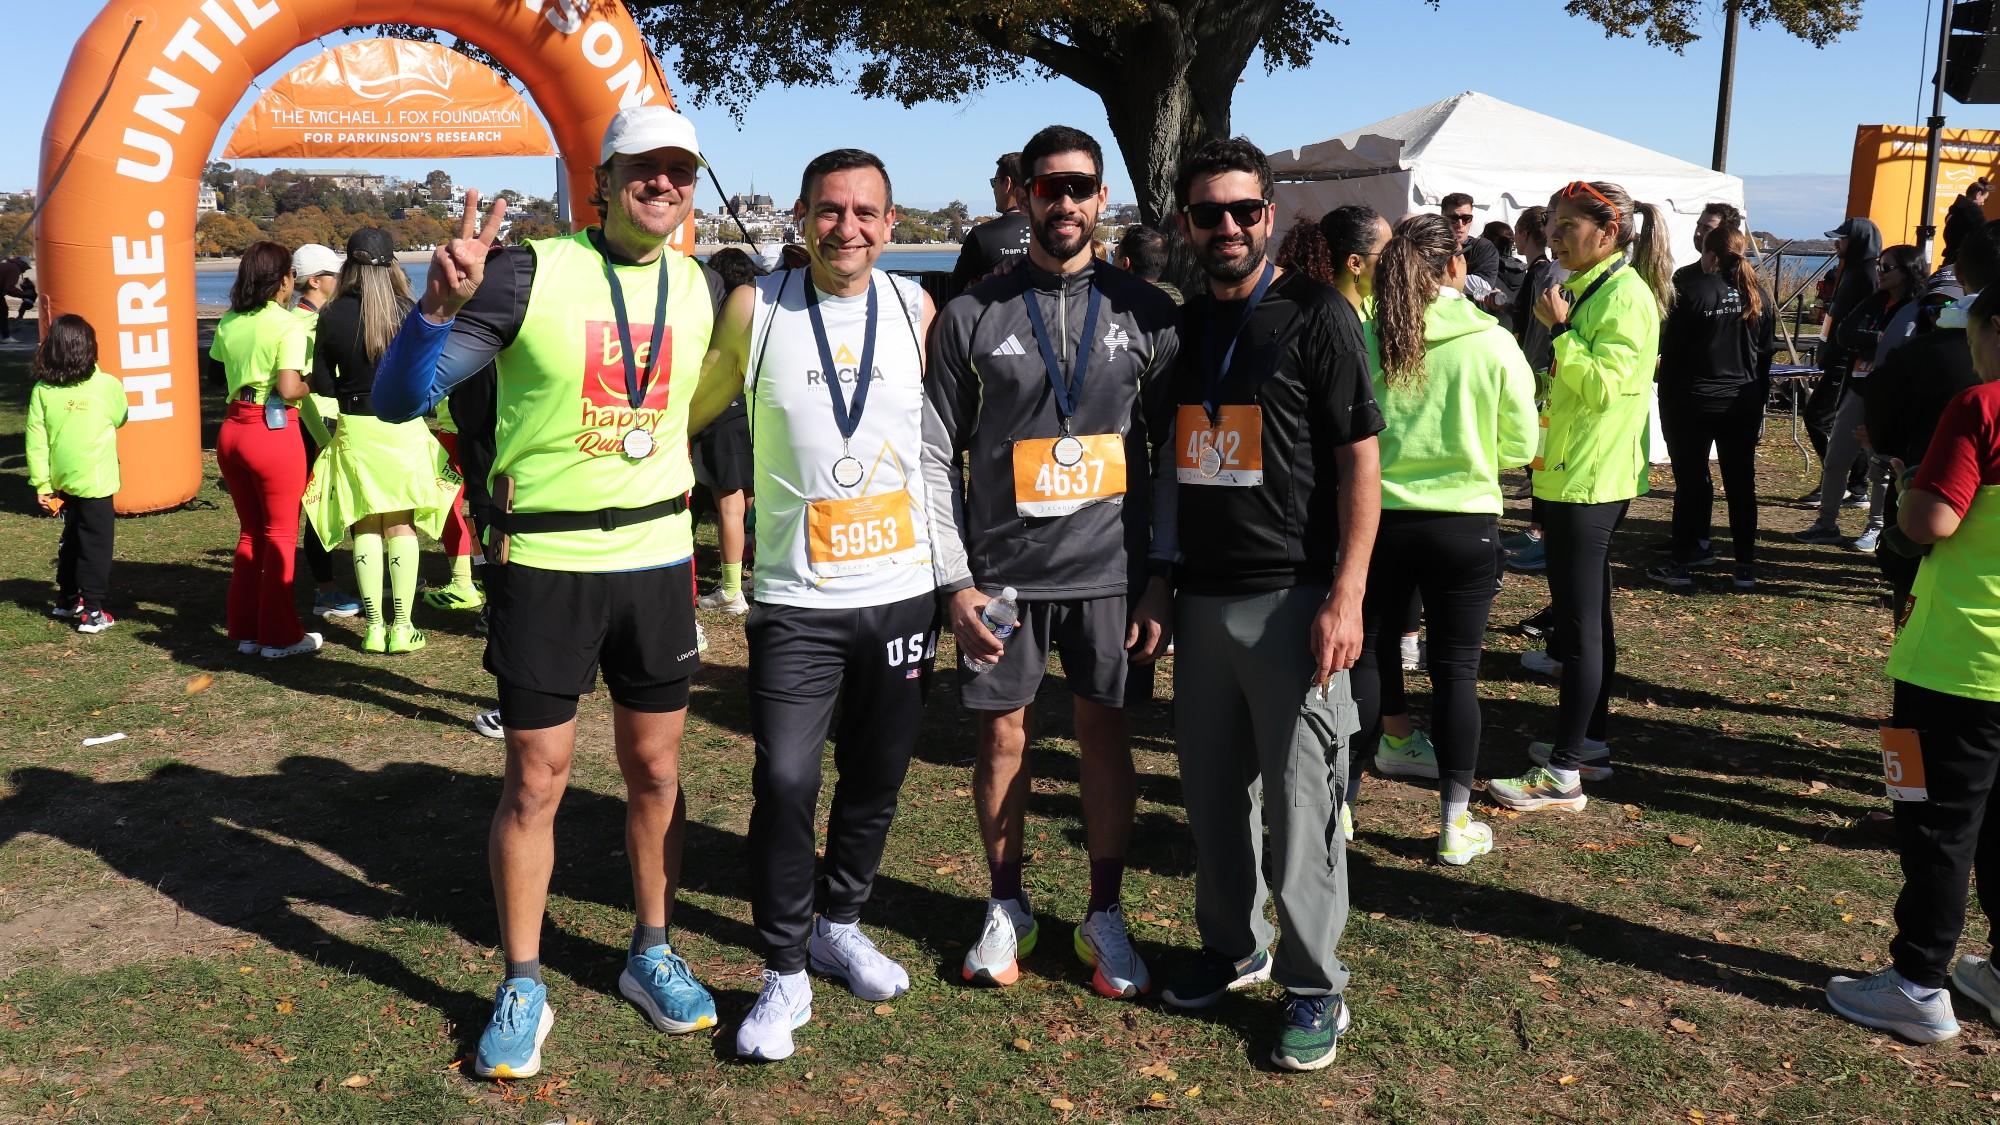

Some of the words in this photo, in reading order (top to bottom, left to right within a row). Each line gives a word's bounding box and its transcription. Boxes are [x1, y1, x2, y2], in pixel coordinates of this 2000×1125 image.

[116, 0, 281, 183] UNTIL
[271, 109, 305, 124] THE
[309, 110, 380, 124] MICHAEL
[383, 111, 395, 124] J.
[399, 110, 429, 124] FOX
[433, 109, 521, 124] FOUNDATION
[303, 132, 333, 143] FOR
[338, 132, 432, 143] PARKINSON'S
[436, 131, 502, 142] RESEARCH
[1000, 247, 1021, 255] Team
[112, 210, 174, 422] HERE.
[581, 401, 664, 437] happy
[1035, 459, 1105, 497] 4637
[830, 516, 898, 558] 5953
[886, 630, 936, 667] USA
